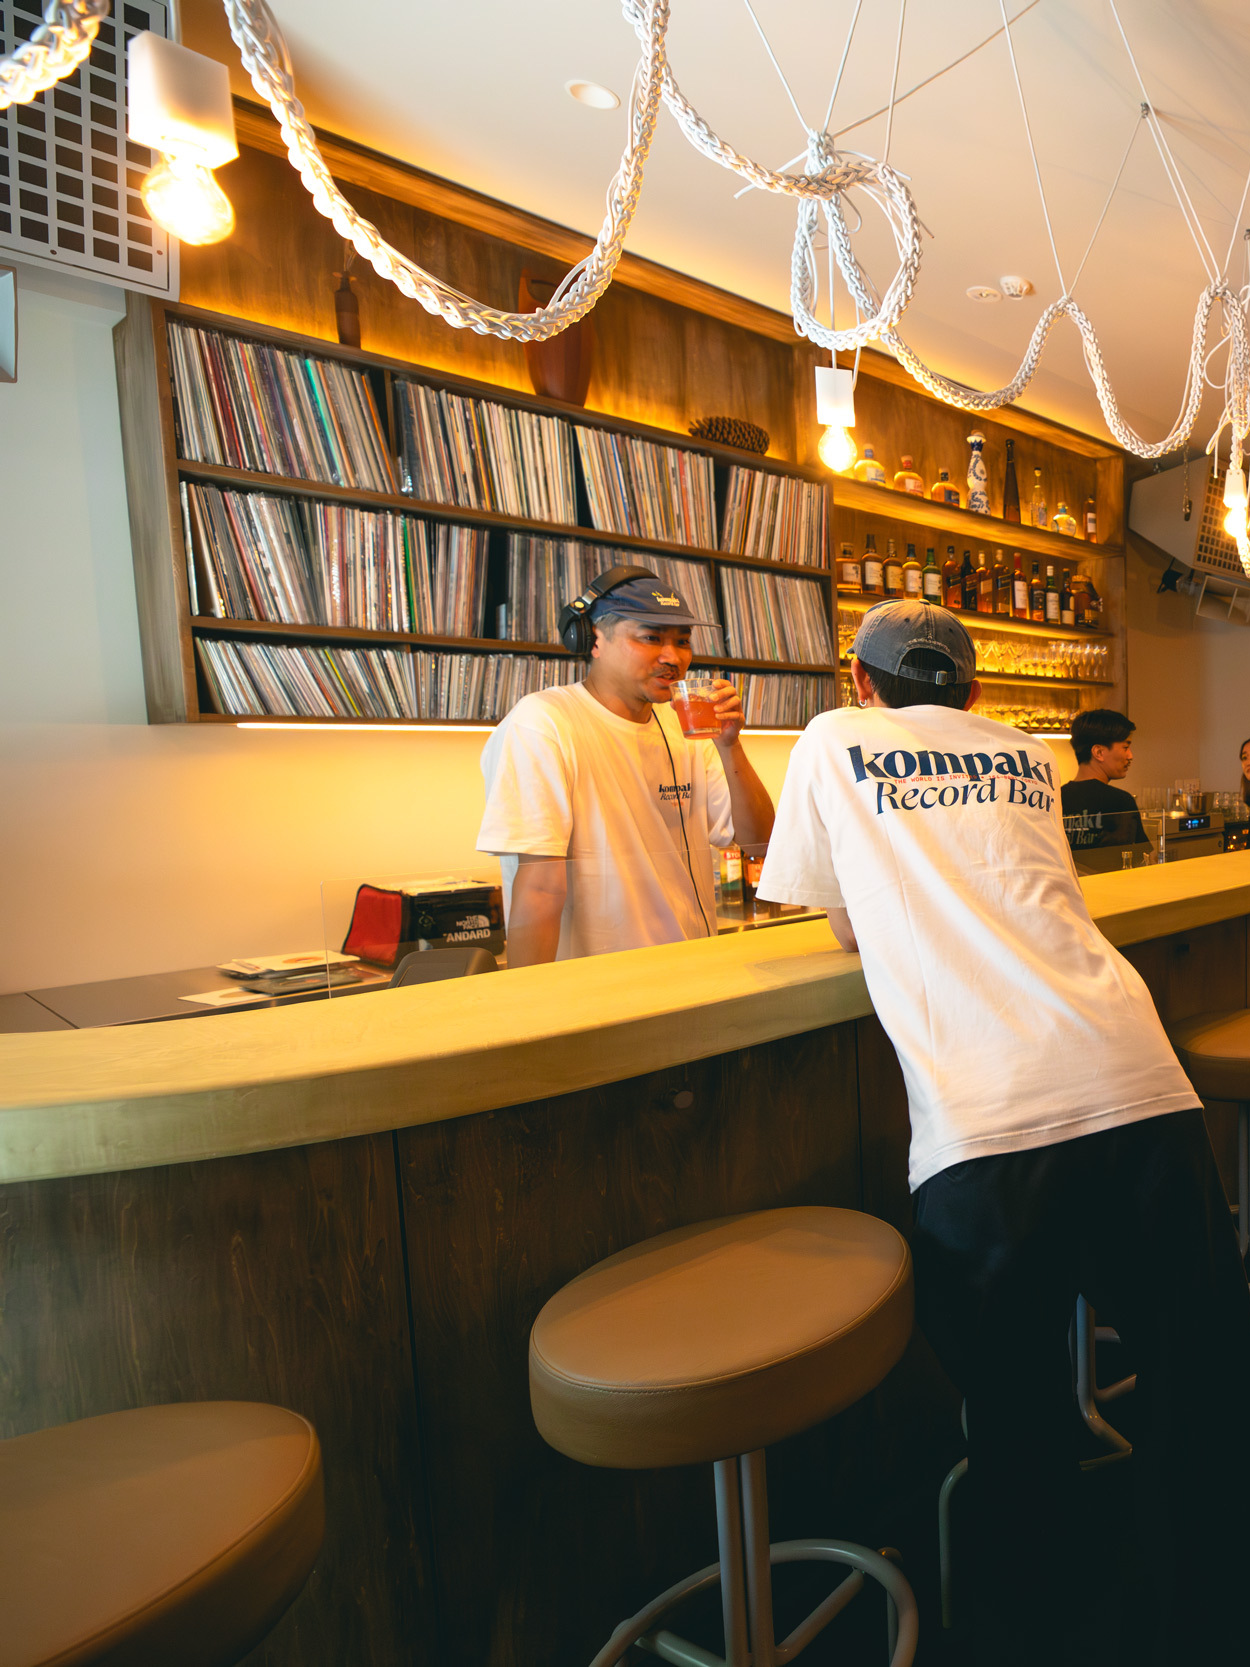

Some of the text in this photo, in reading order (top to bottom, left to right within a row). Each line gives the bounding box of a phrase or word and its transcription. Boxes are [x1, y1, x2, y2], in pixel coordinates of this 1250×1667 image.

[847, 745, 1055, 791] kompakt
[876, 777, 1055, 815] Record Bar
[443, 928, 491, 943] ANDARD
